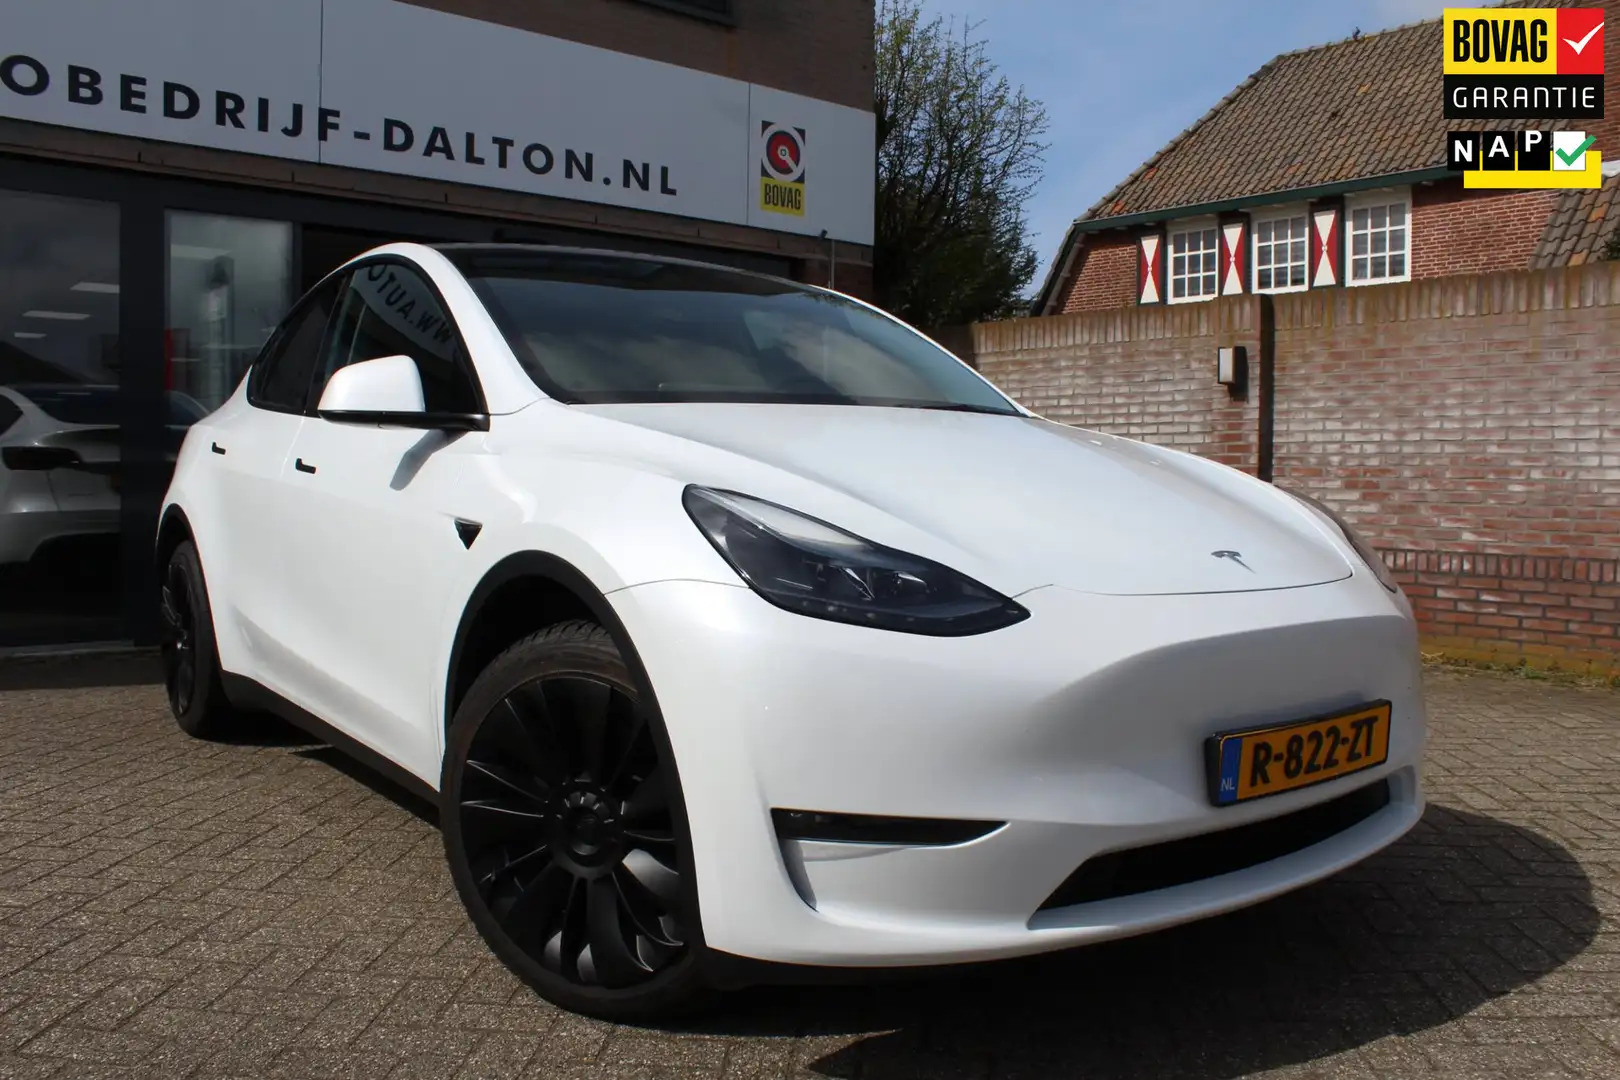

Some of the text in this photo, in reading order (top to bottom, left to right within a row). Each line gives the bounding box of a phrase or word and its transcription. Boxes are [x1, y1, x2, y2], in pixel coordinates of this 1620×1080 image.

[0, 54, 678, 196] OBEDRIJF-DALTON.NL
[764, 183, 801, 210] BOVAG
[1250, 716, 1378, 787] R-822-ZT
[1220, 777, 1235, 791] NL
